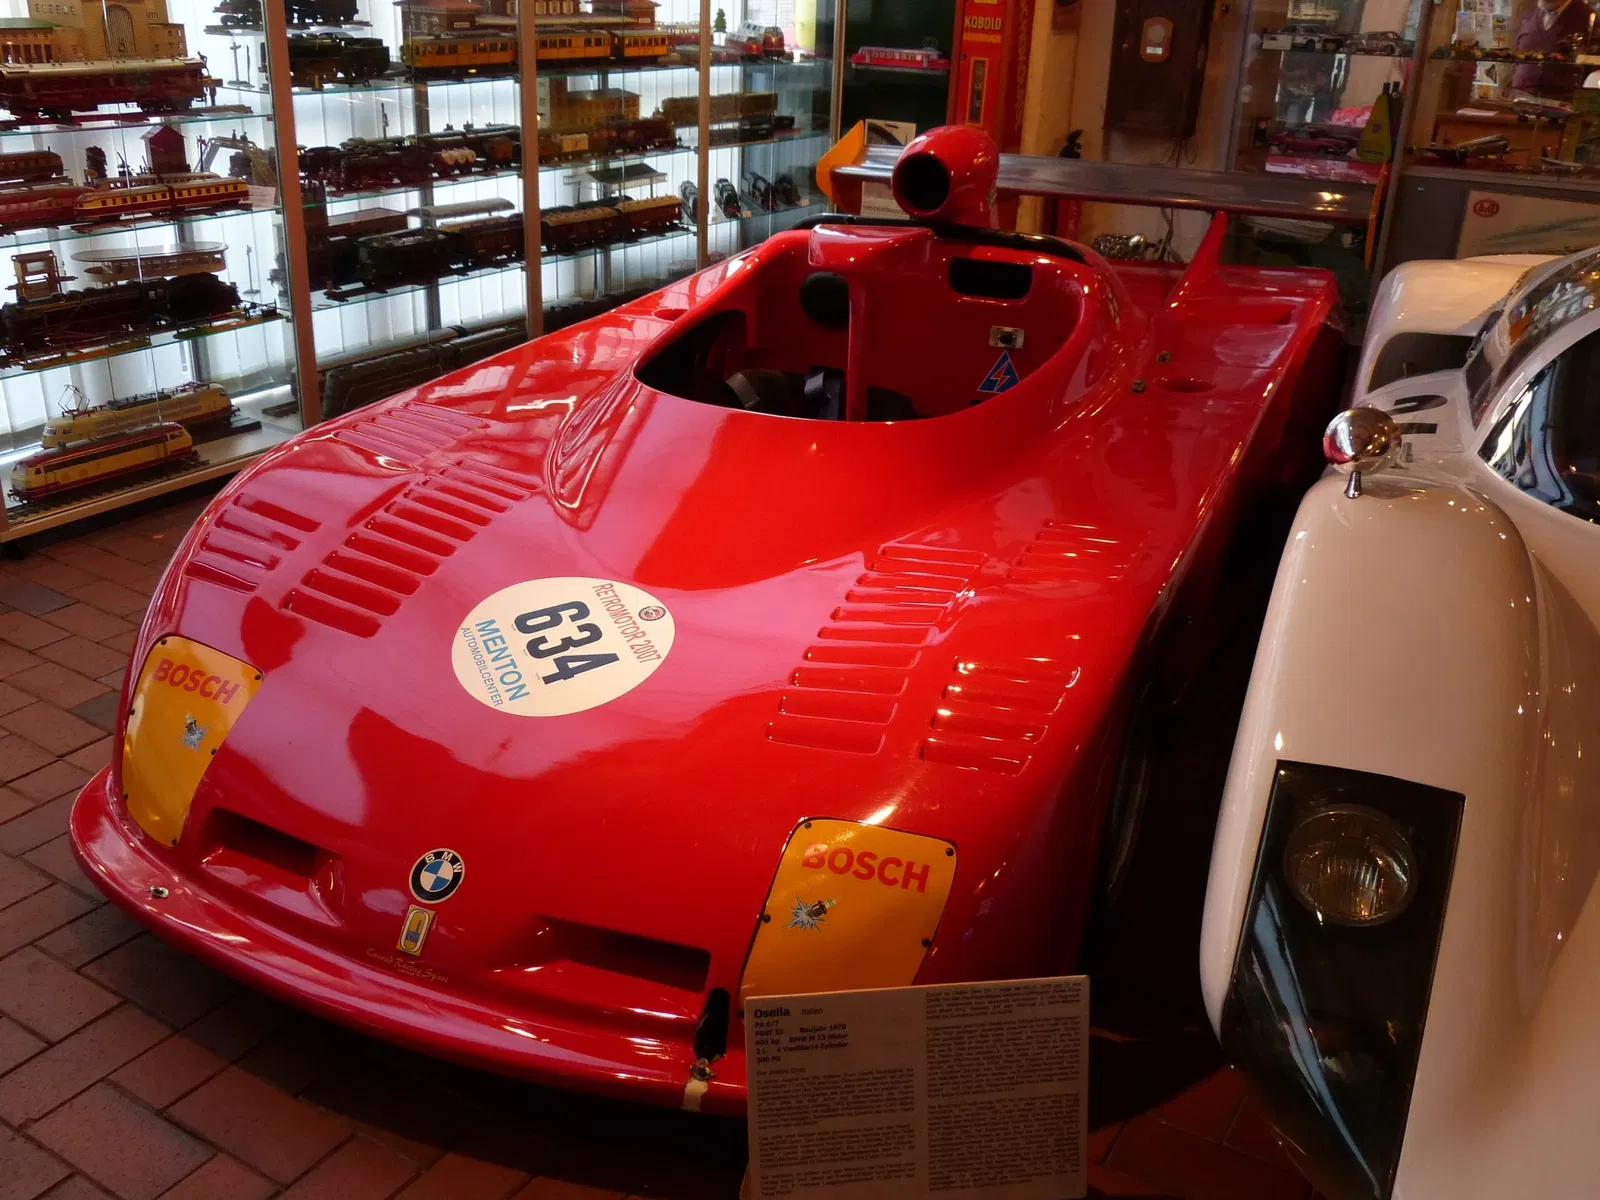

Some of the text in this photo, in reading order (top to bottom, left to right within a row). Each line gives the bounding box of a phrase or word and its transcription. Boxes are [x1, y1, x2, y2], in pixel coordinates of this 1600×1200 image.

[964, 15, 1002, 30] KOBOLD
[514, 601, 620, 685] 634
[592, 583, 646, 642] RETROMOTOR
[629, 640, 662, 663] 2007
[153, 659, 240, 704] BOSCH
[461, 627, 503, 706] AUTOMOBILCENTER
[475, 619, 530, 701] MENTON
[425, 852, 462, 873] BMW
[801, 843, 930, 893] BOSCH
[394, 958, 422, 976] Racing
[422, 969, 449, 983] Sport
[754, 1007, 790, 1018] Osella
